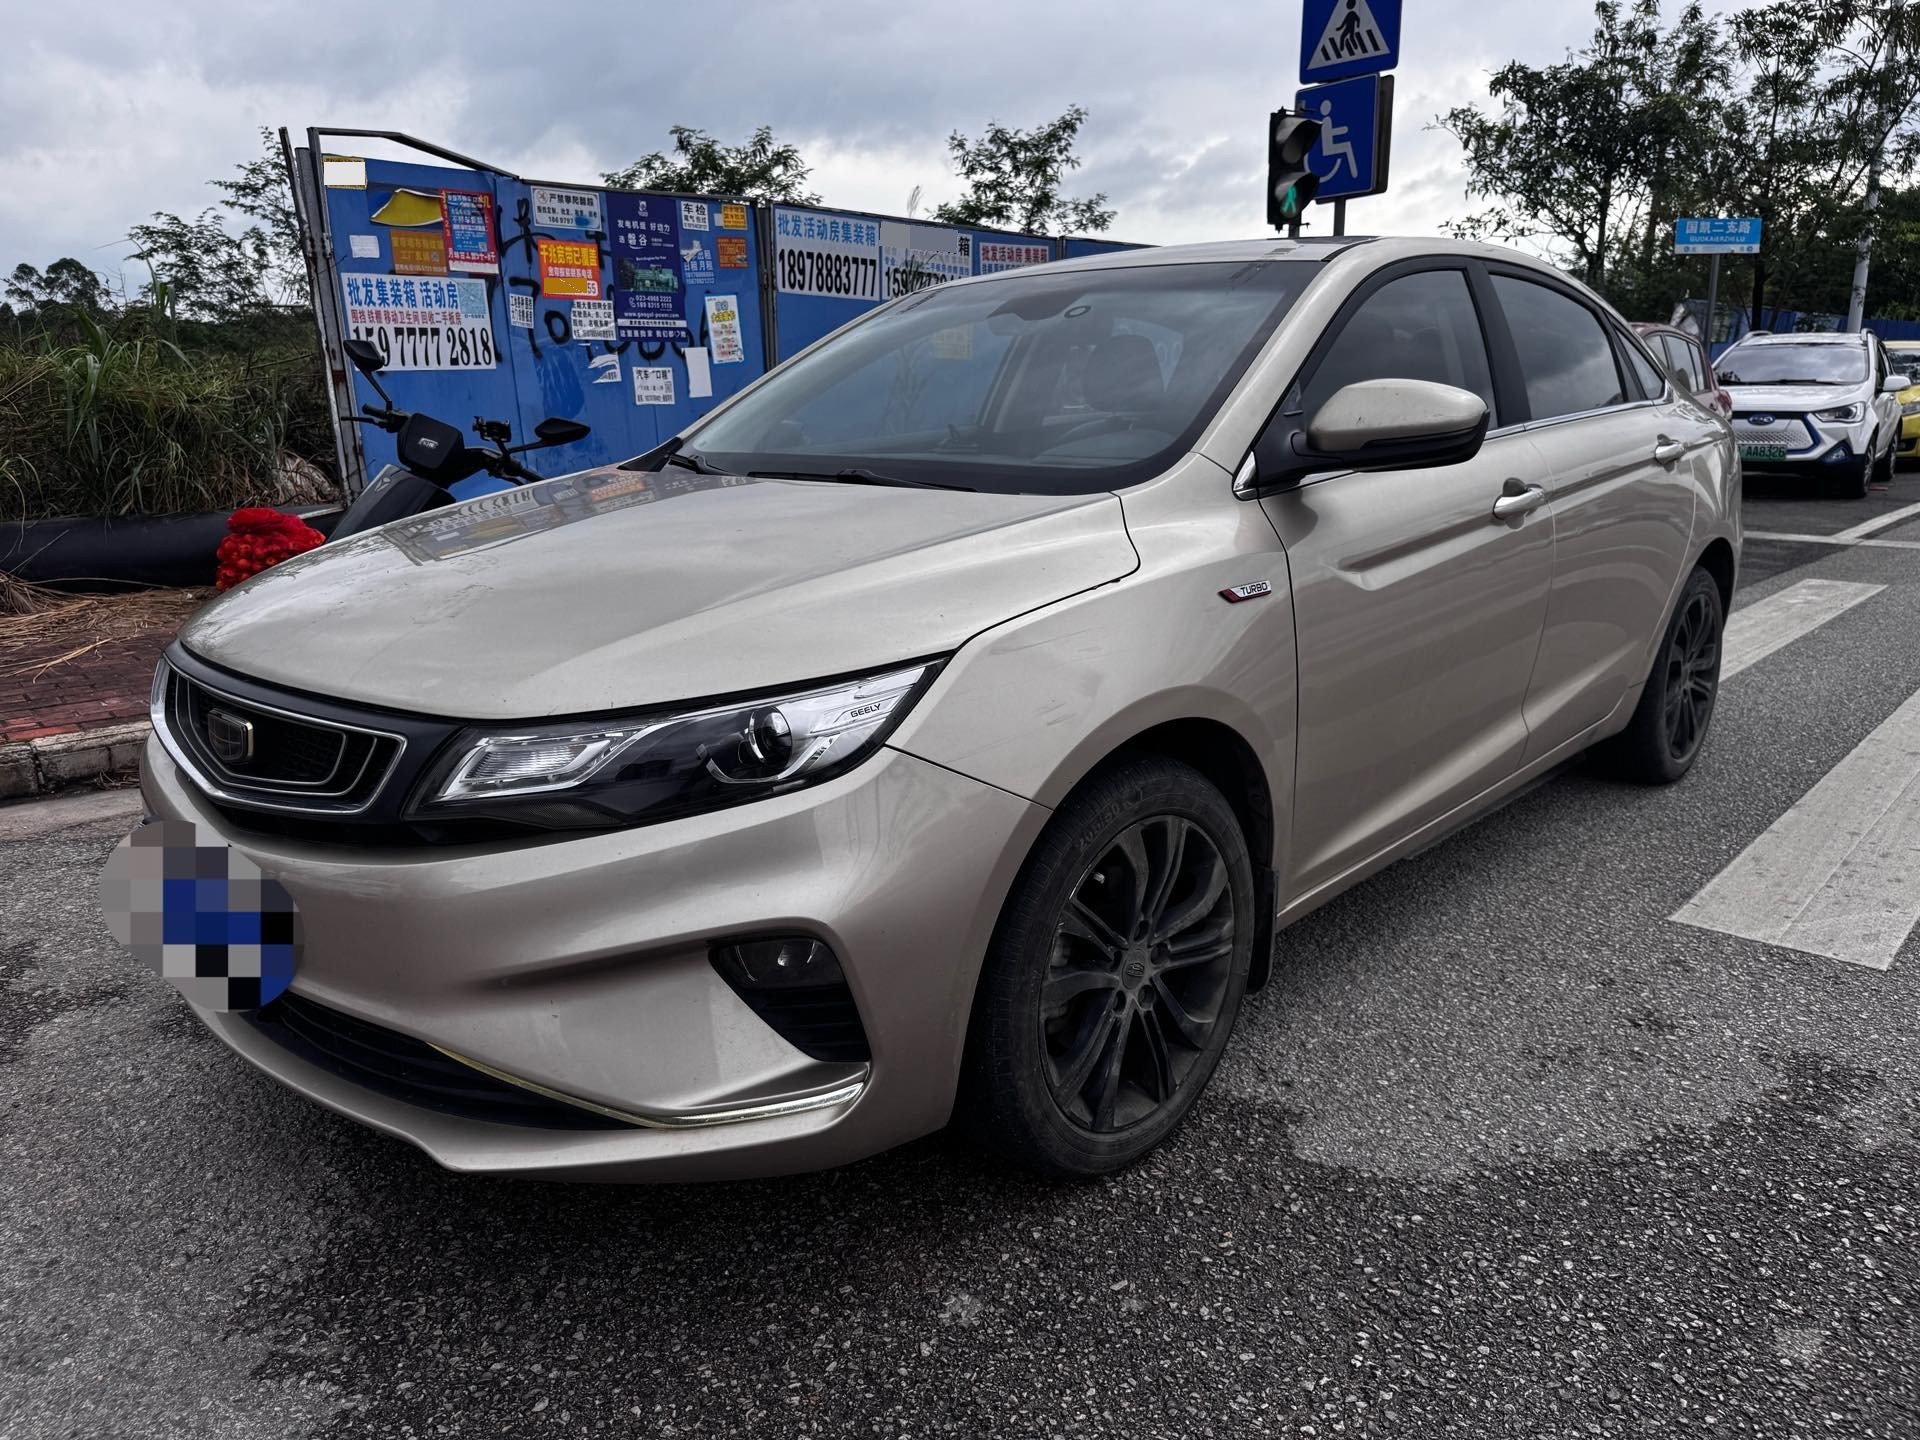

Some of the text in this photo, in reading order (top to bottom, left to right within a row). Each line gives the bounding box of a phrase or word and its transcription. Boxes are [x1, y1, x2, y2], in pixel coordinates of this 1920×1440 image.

[683, 203, 706, 216] 车检
[617, 219, 647, 230] 发电机组
[649, 222, 671, 233] 好动力
[777, 212, 877, 247] 批发活动房集装箱
[1685, 220, 1751, 234] 国凯二支路
[540, 244, 598, 266] 千兆宽带已覆盖
[981, 244, 1023, 262] 批发活动房
[778, 248, 878, 297] 18978883777
[347, 277, 459, 310] 批发集装箱 活动房
[394, 327, 441, 367] 7777
[446, 327, 492, 366] 2818
[1240, 582, 1268, 595] TURBO
[850, 703, 881, 718] GEELY
